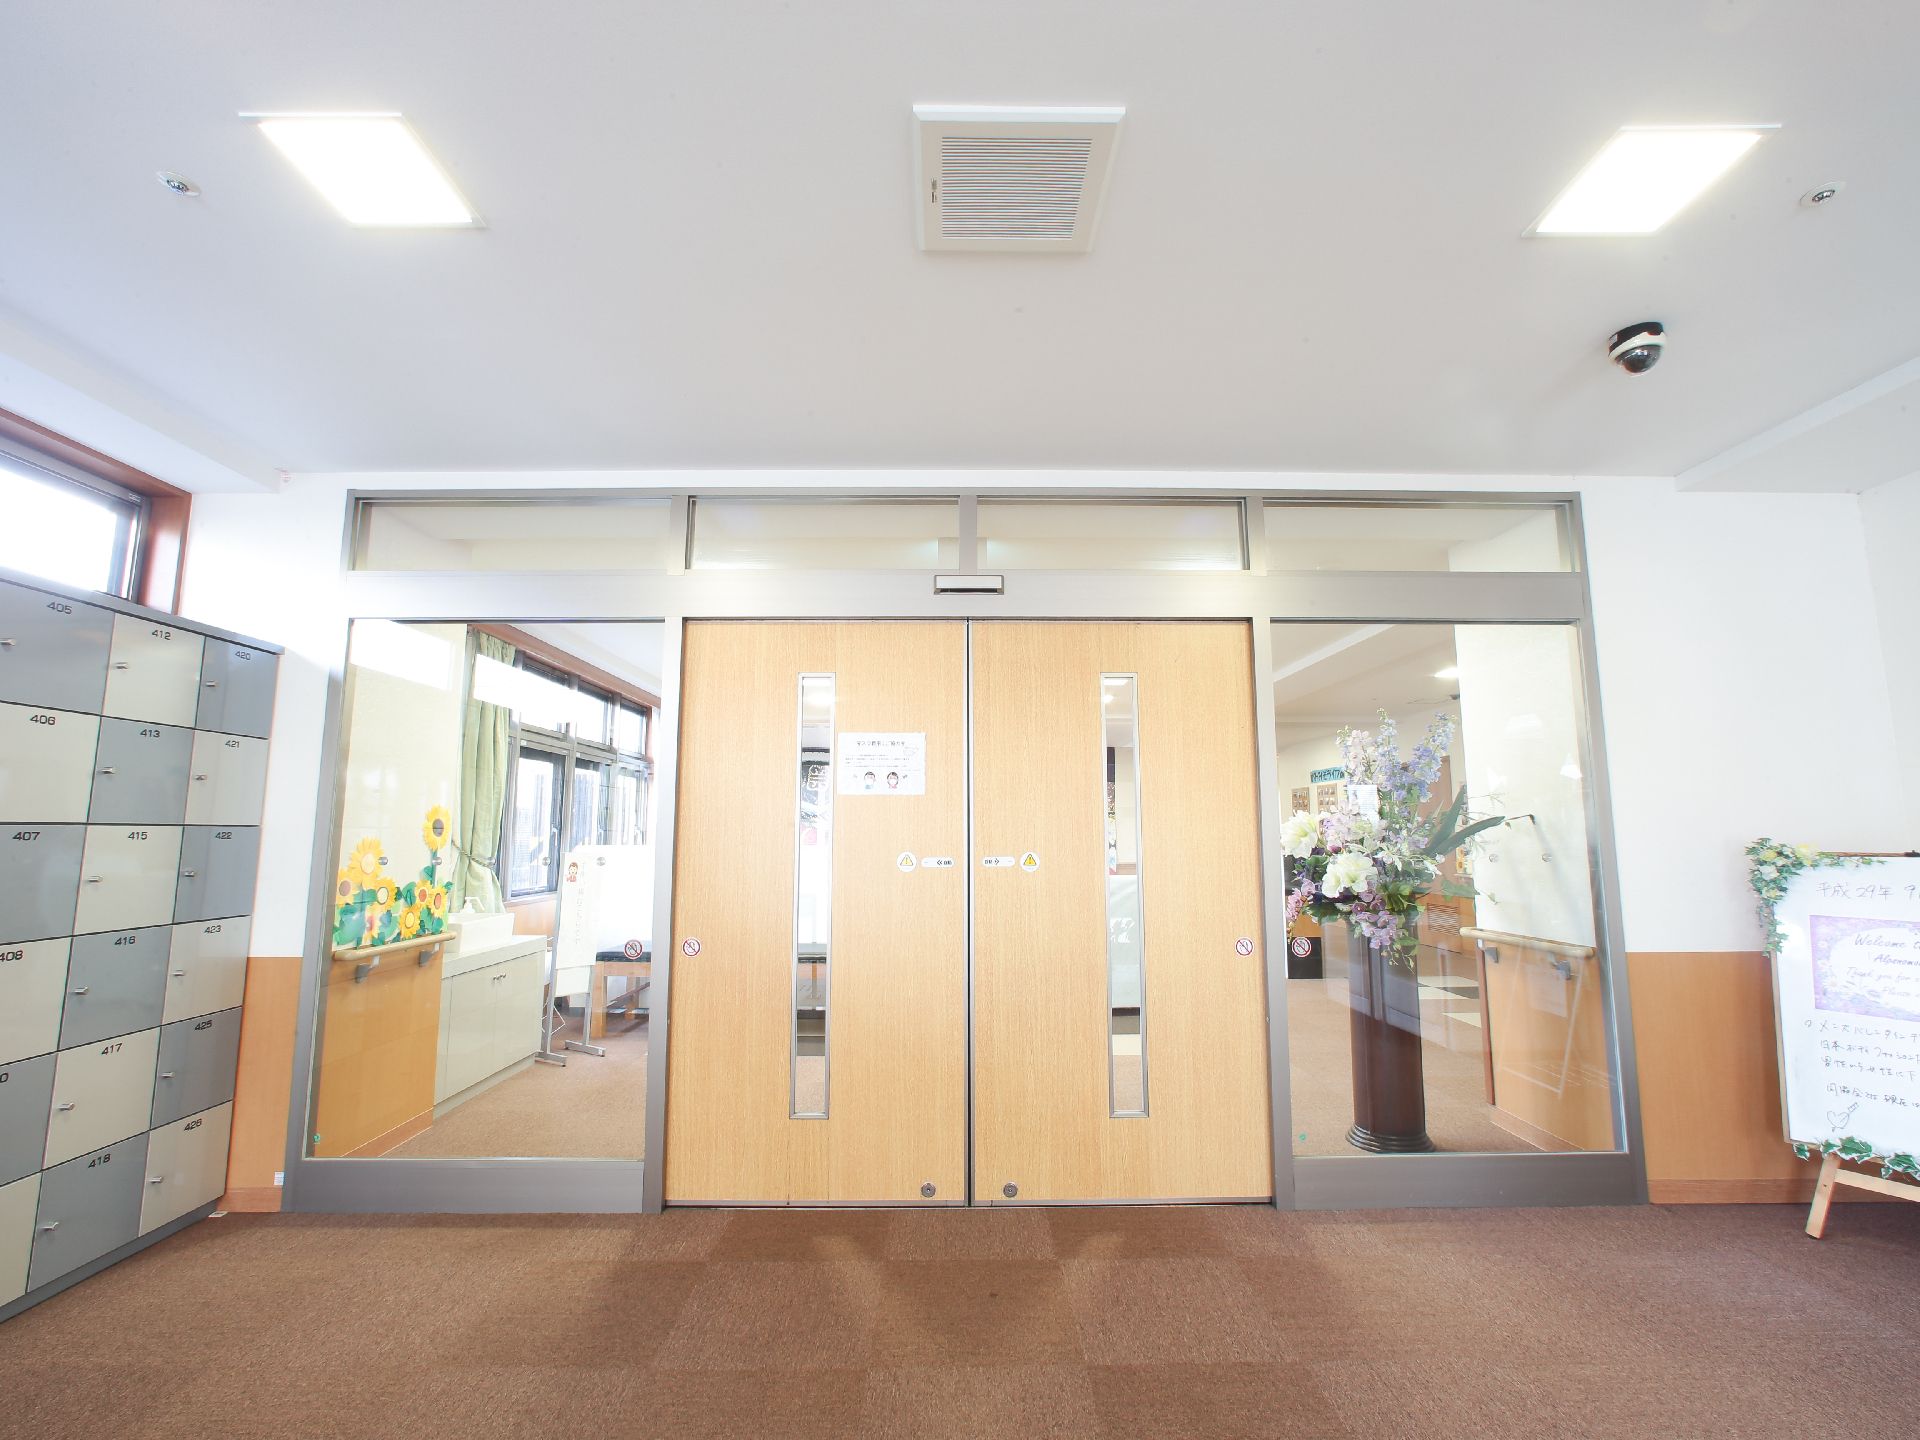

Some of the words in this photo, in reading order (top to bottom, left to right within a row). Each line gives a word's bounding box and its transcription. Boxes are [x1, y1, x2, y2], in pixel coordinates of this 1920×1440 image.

[46, 601, 73, 615] 405
[151, 629, 172, 641] 412
[234, 650, 252, 661] 420
[29, 714, 57, 726] 406
[139, 729, 161, 739] 413
[224, 740, 241, 749] 421
[12, 831, 41, 842] 407
[127, 831, 148, 841] 415
[214, 831, 233, 840] 422
[203, 924, 222, 935] 423
[113, 935, 136, 947] 416
[193, 1018, 214, 1032] 425
[100, 1042, 123, 1056] 417
[183, 1118, 203, 1132] 426
[87, 1153, 112, 1169] 418
